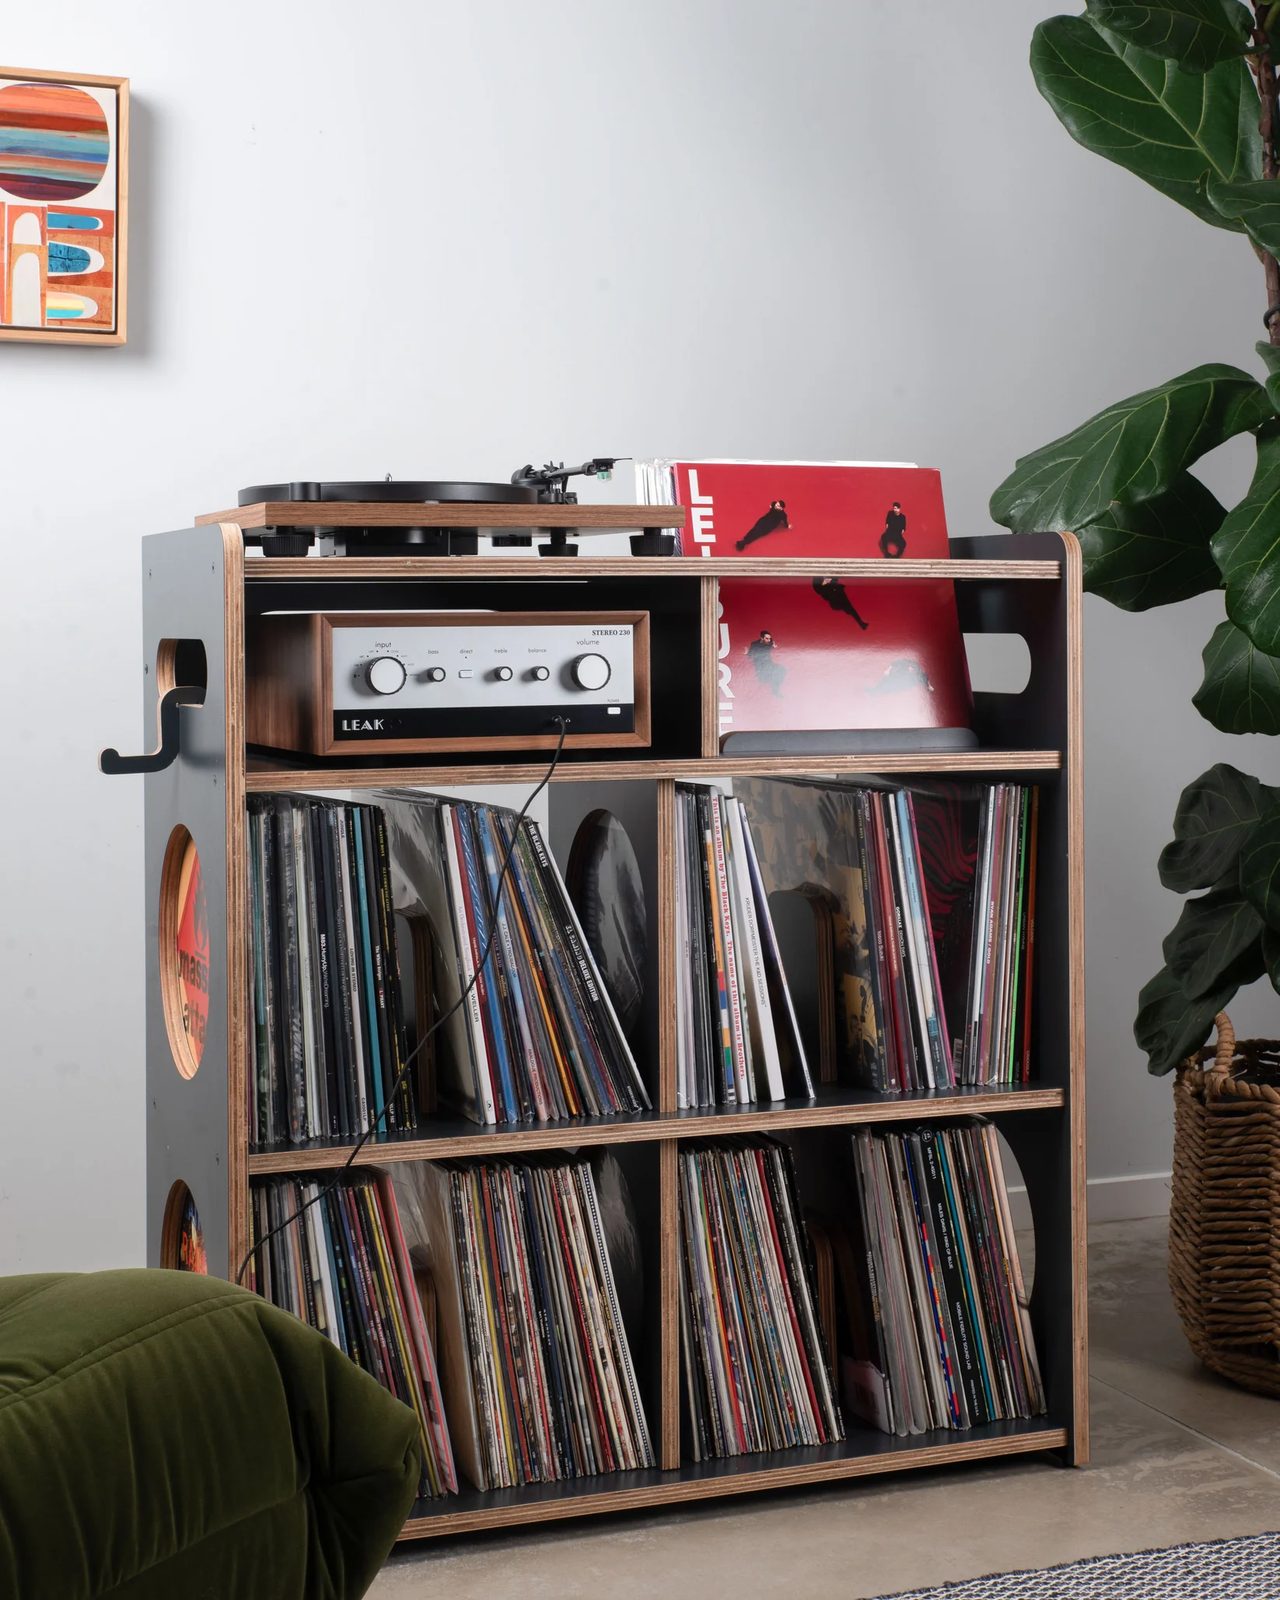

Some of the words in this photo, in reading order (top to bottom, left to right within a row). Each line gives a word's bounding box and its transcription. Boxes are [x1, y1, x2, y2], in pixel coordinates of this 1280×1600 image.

[576, 638, 600, 646] volume
[342, 719, 385, 731] LEAK
[528, 823, 537, 835] THE
[715, 825, 720, 834] an
[532, 834, 543, 852] BLACK
[716, 837, 724, 861] album
[538, 852, 549, 867] KEYS
[718, 863, 725, 872] by
[745, 896, 754, 918] KRUDER
[748, 918, 759, 955] DORFMEISTER
[459, 913, 469, 946] Orchestrated
[471, 993, 480, 1022] WELLER
[578, 958, 591, 980] DELUXE
[586, 978, 600, 1001] EDITION
[734, 1007, 742, 1031] album
[528, 1047, 537, 1072] ANALOGUE
[533, 1072, 543, 1105] PRODUCTIONS
[959, 1320, 967, 1340] FIDELITY
